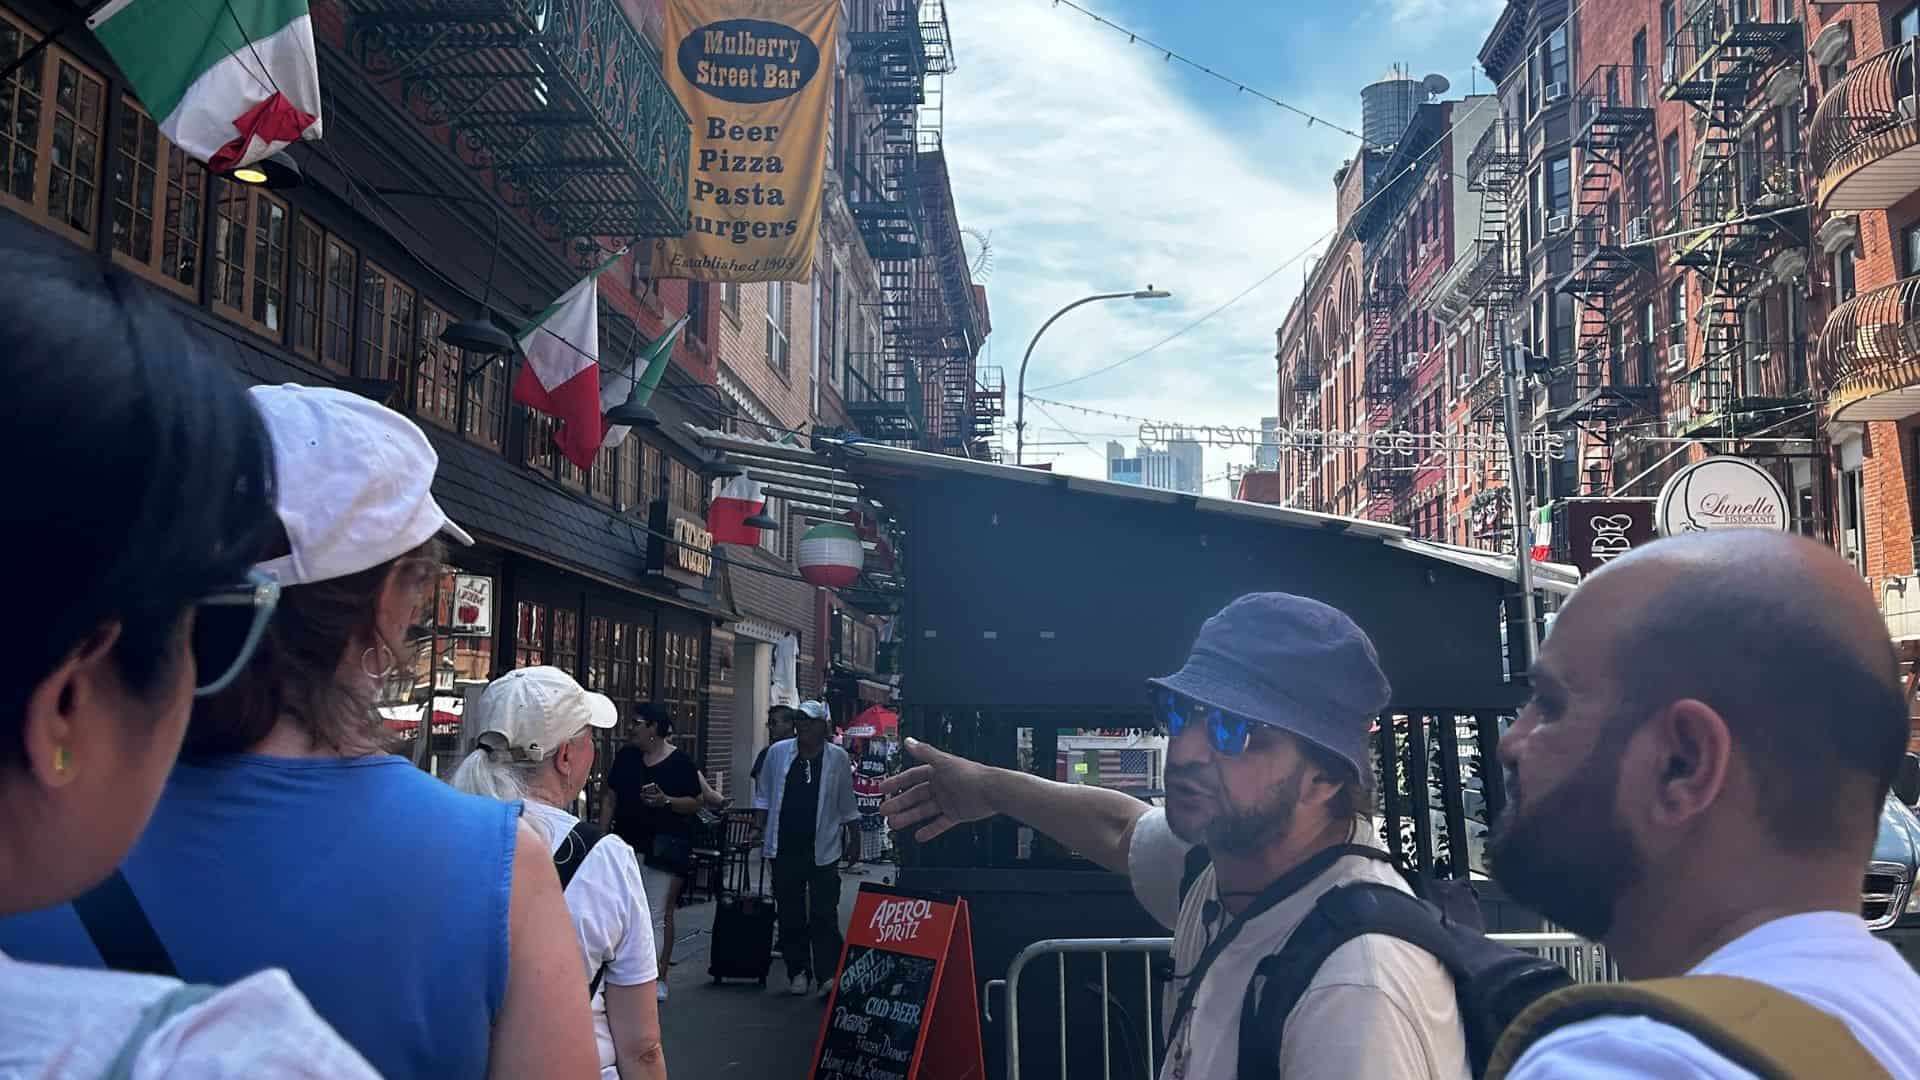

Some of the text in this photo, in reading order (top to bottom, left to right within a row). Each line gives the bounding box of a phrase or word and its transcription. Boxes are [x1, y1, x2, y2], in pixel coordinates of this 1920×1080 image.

[704, 30, 800, 63] Mulberry
[696, 60, 800, 89] Street Bar
[707, 116, 780, 142] Beer
[698, 149, 784, 174] Pizza
[694, 179, 785, 206] Pasta
[670, 253, 760, 272] Established
[1697, 493, 1776, 517] Lunella
[1725, 515, 1776, 525] RISTORANTE
[857, 797, 881, 807] FDNY
[869, 899, 934, 929] APEROL
[840, 948, 875, 993] GREAT
[865, 996, 921, 1025] COLD BEER
